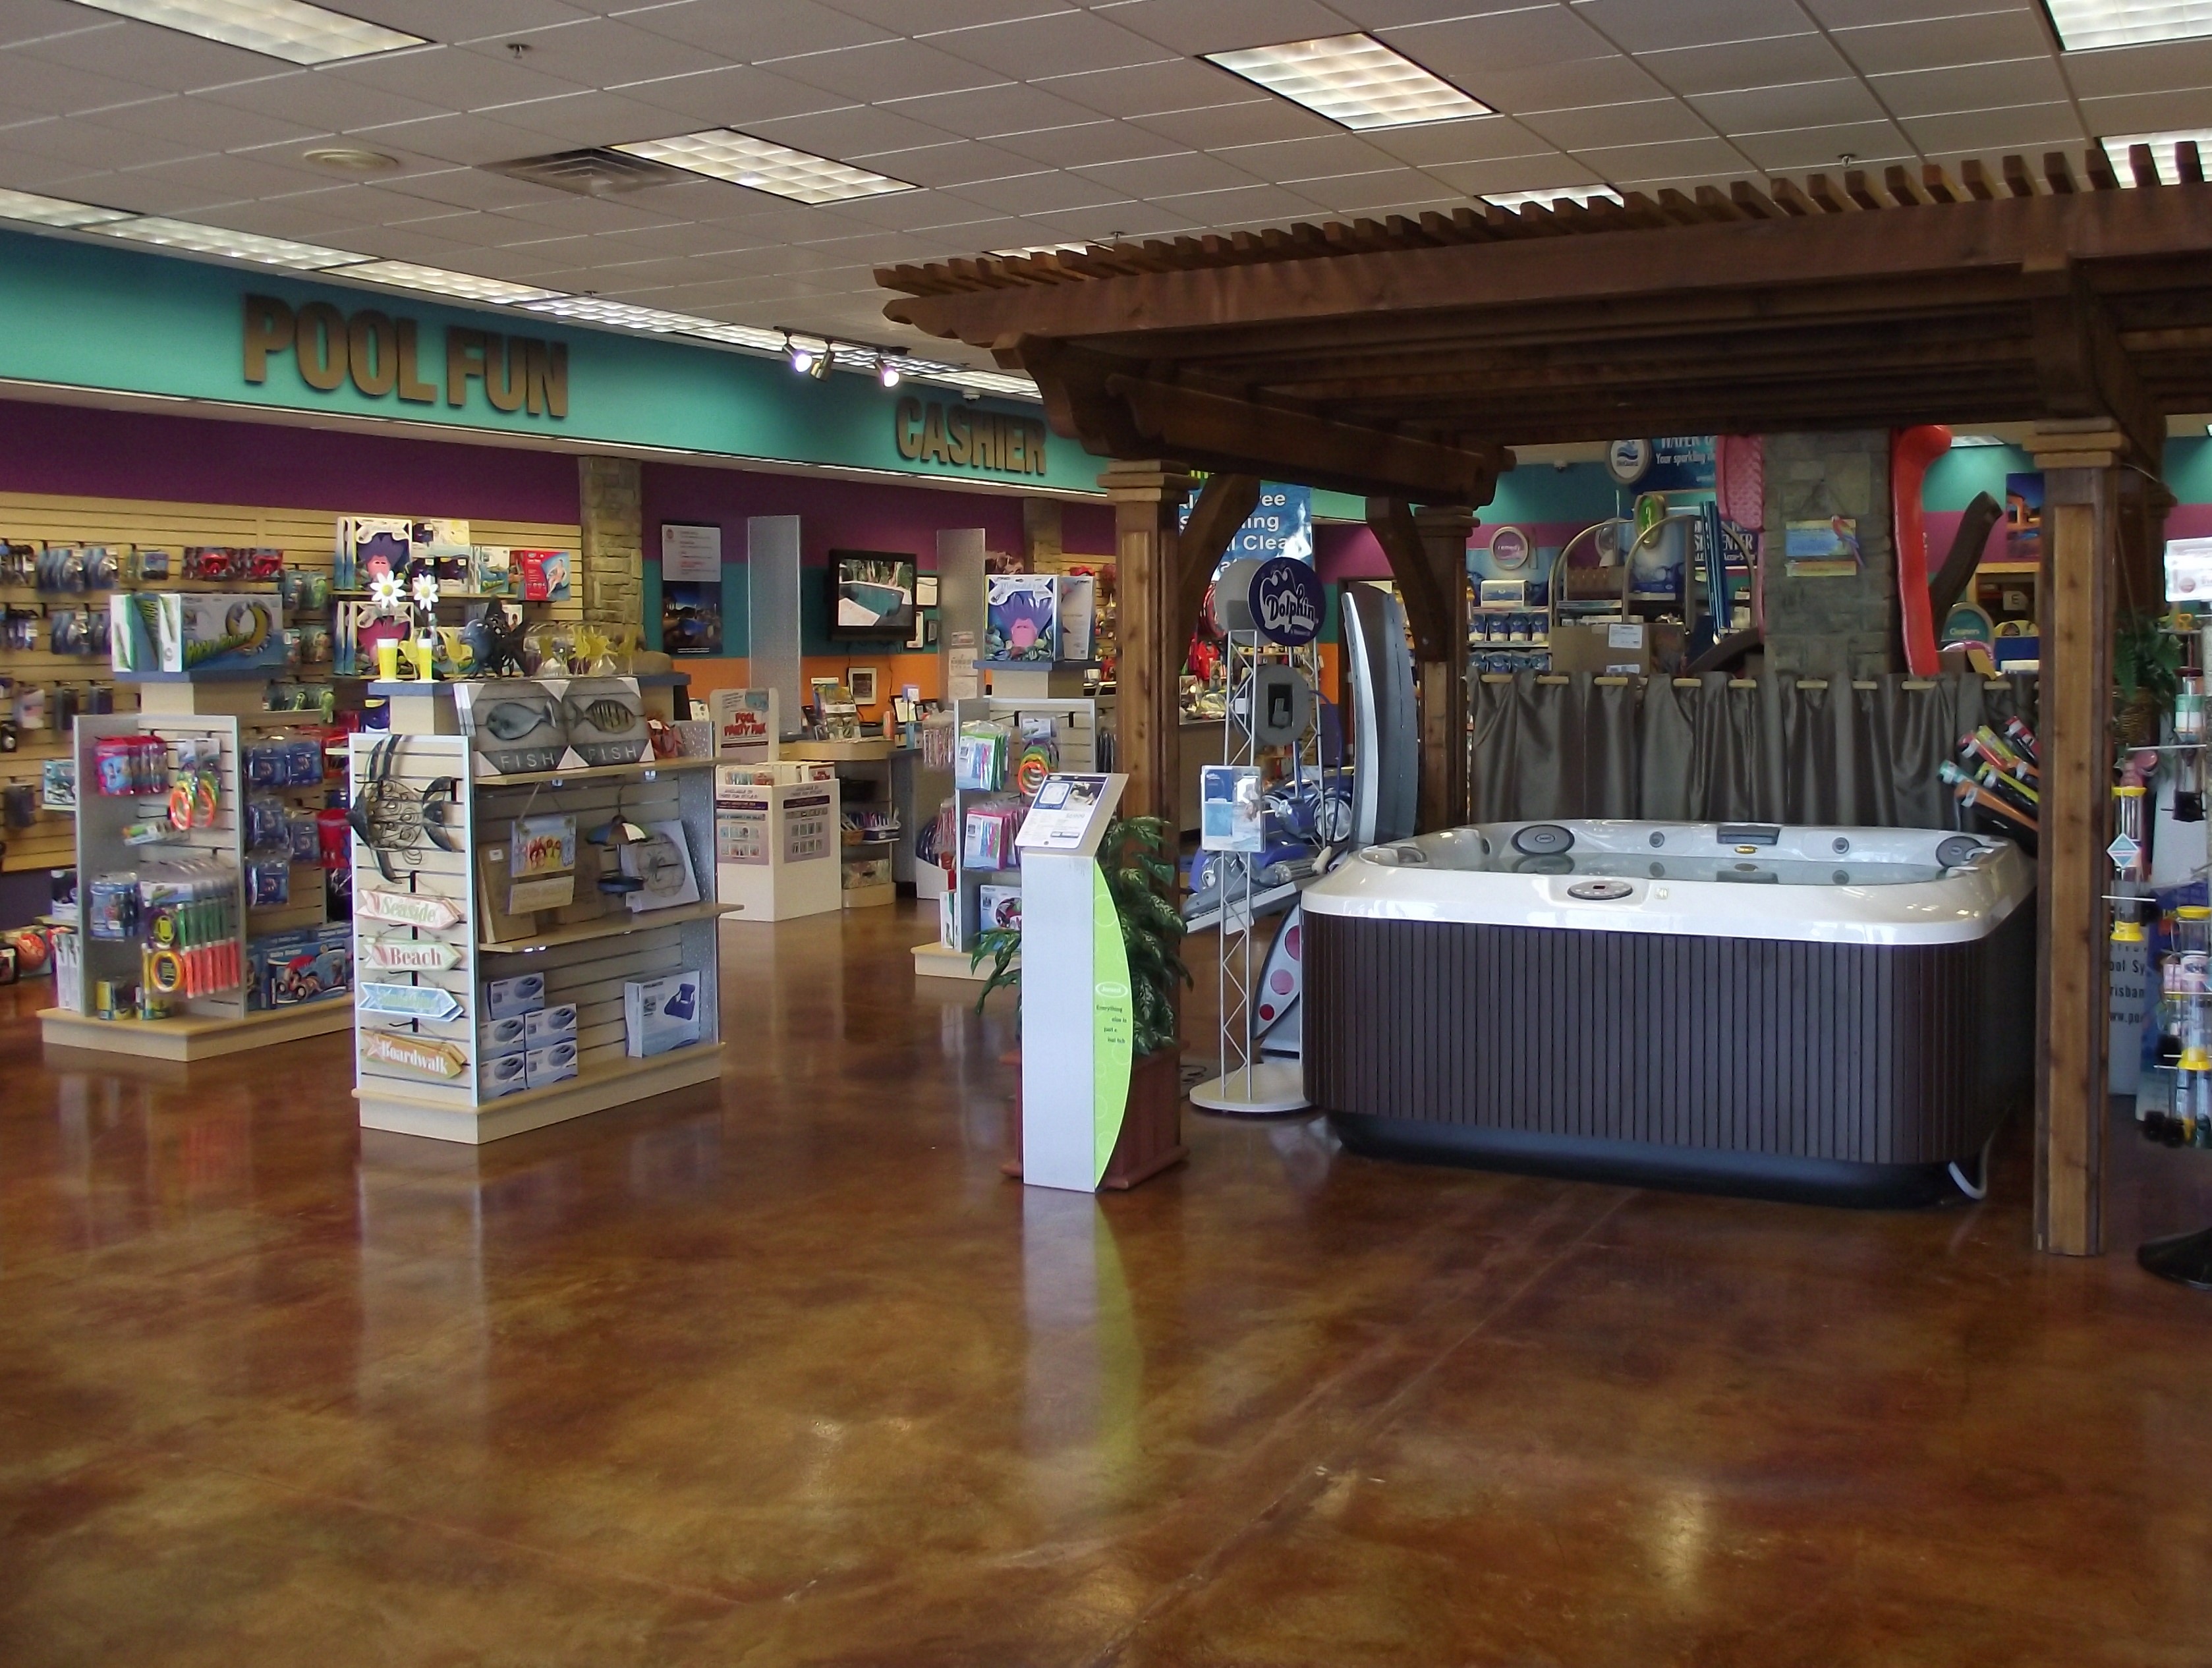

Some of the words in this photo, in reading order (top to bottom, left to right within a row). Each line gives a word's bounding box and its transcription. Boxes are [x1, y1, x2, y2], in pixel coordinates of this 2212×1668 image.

[242, 293, 438, 404] POOL
[446, 325, 569, 418] FUN
[896, 397, 1046, 475] CASHIER
[1655, 453, 1672, 464] Your
[1243, 535, 1289, 550] Clea
[1265, 584, 1315, 625] Dolphin
[2011, 594, 2020, 604] E
[500, 752, 555, 769] FISH
[588, 746, 637, 762] FISH
[382, 897, 437, 922] Seaside
[389, 947, 442, 966] Beach
[2109, 985, 2145, 999] risban
[380, 1040, 448, 1074] Boardwalk
